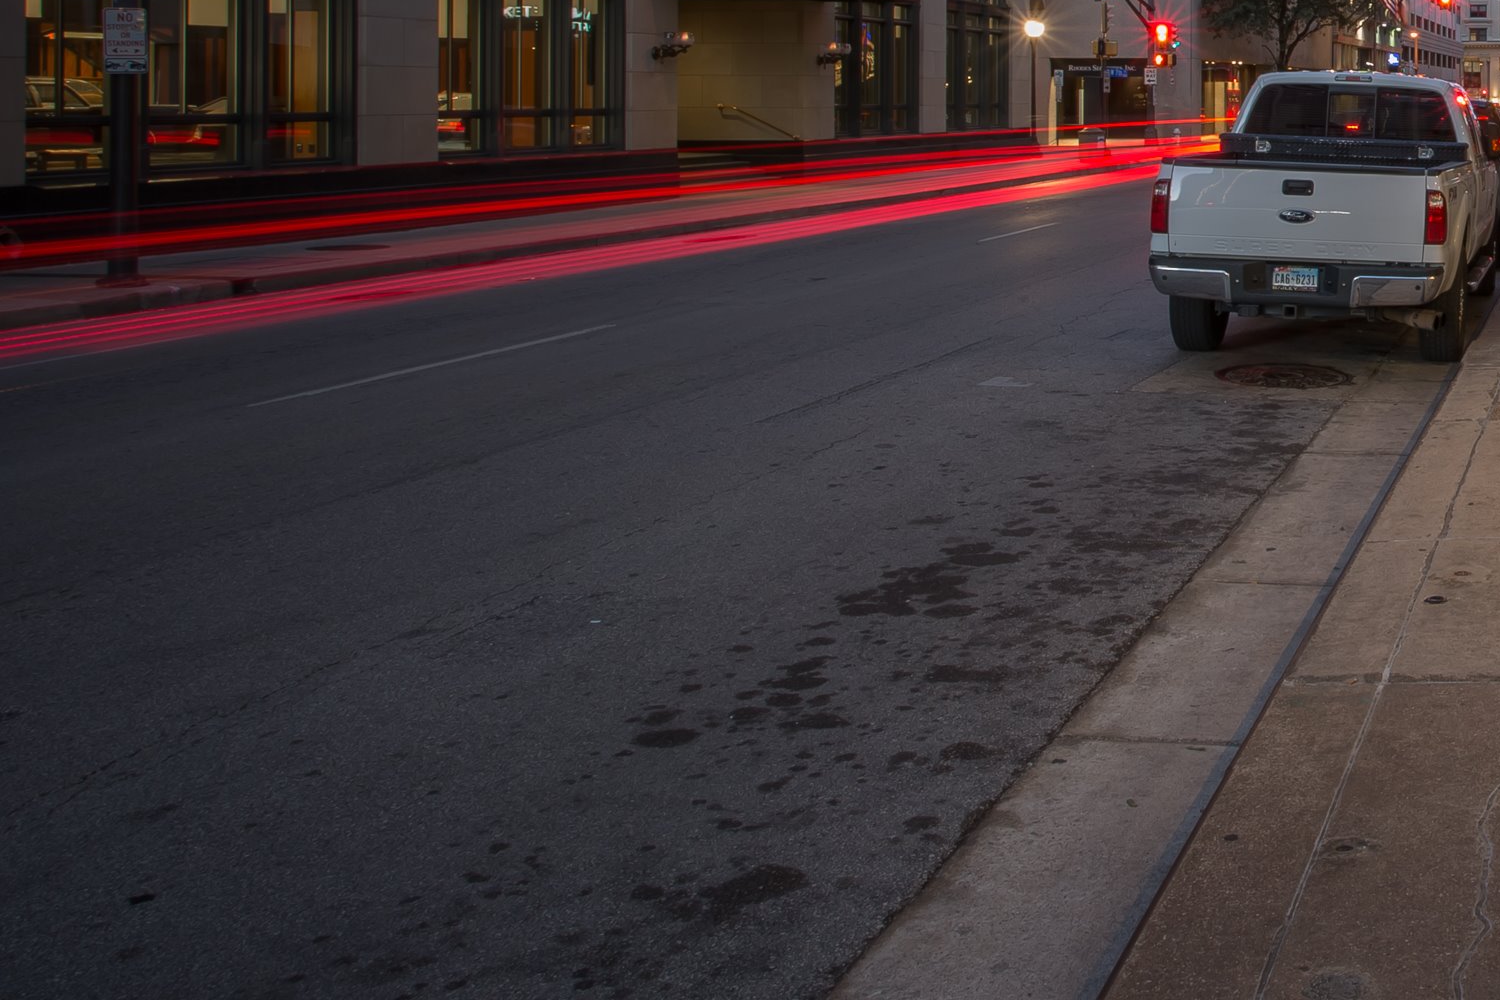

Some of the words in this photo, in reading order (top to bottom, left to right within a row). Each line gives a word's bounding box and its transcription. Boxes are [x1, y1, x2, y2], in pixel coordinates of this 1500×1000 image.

[116, 12, 134, 23] NO
[1214, 239, 1296, 255] SUPER
[1313, 242, 1377, 257] DUTY
